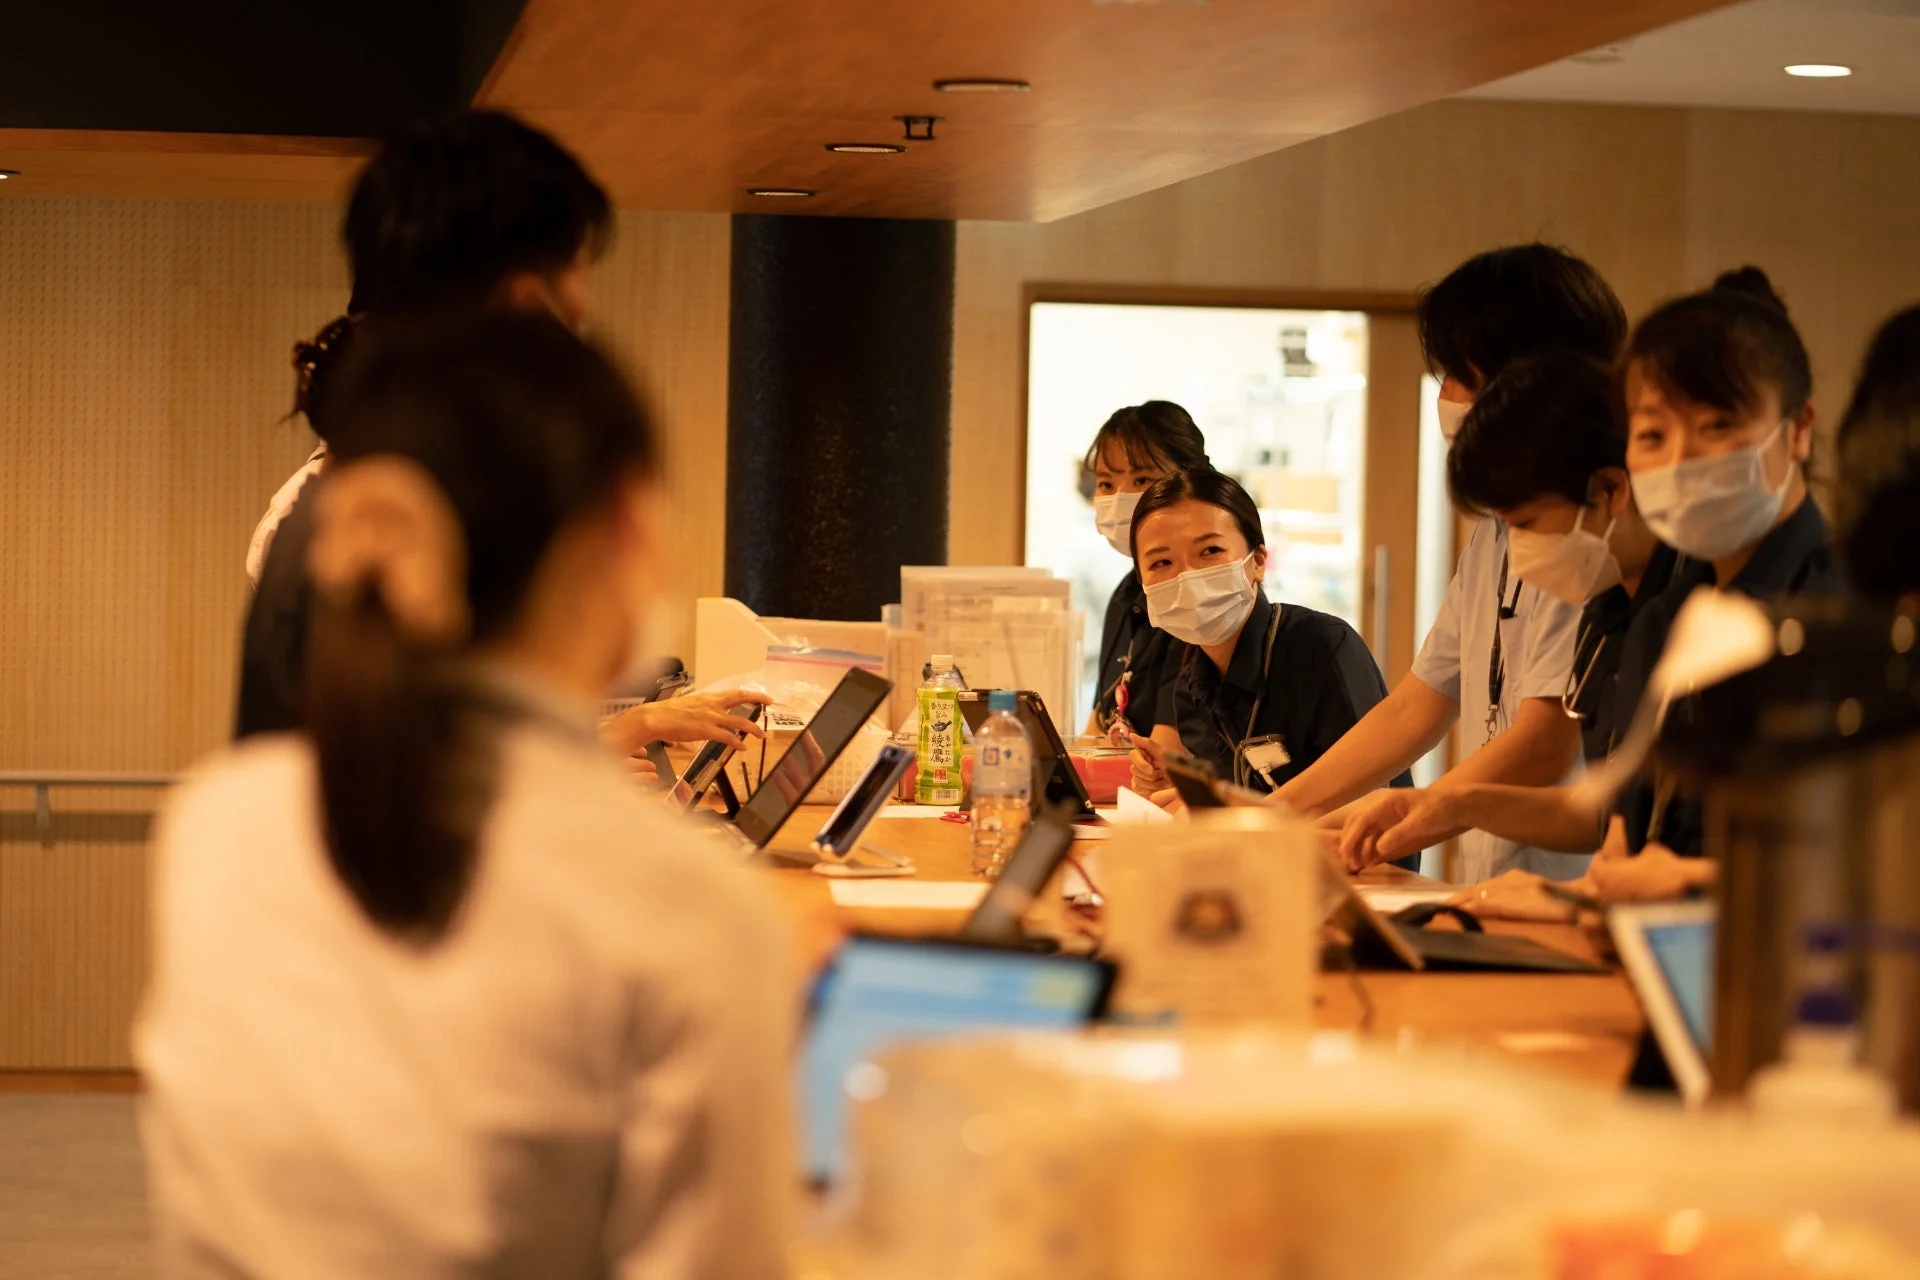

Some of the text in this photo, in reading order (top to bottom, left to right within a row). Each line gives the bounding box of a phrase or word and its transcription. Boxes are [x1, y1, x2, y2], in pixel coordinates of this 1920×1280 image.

[931, 701, 954, 710] 香り立つ
[931, 734, 944, 764] 綾鷹
